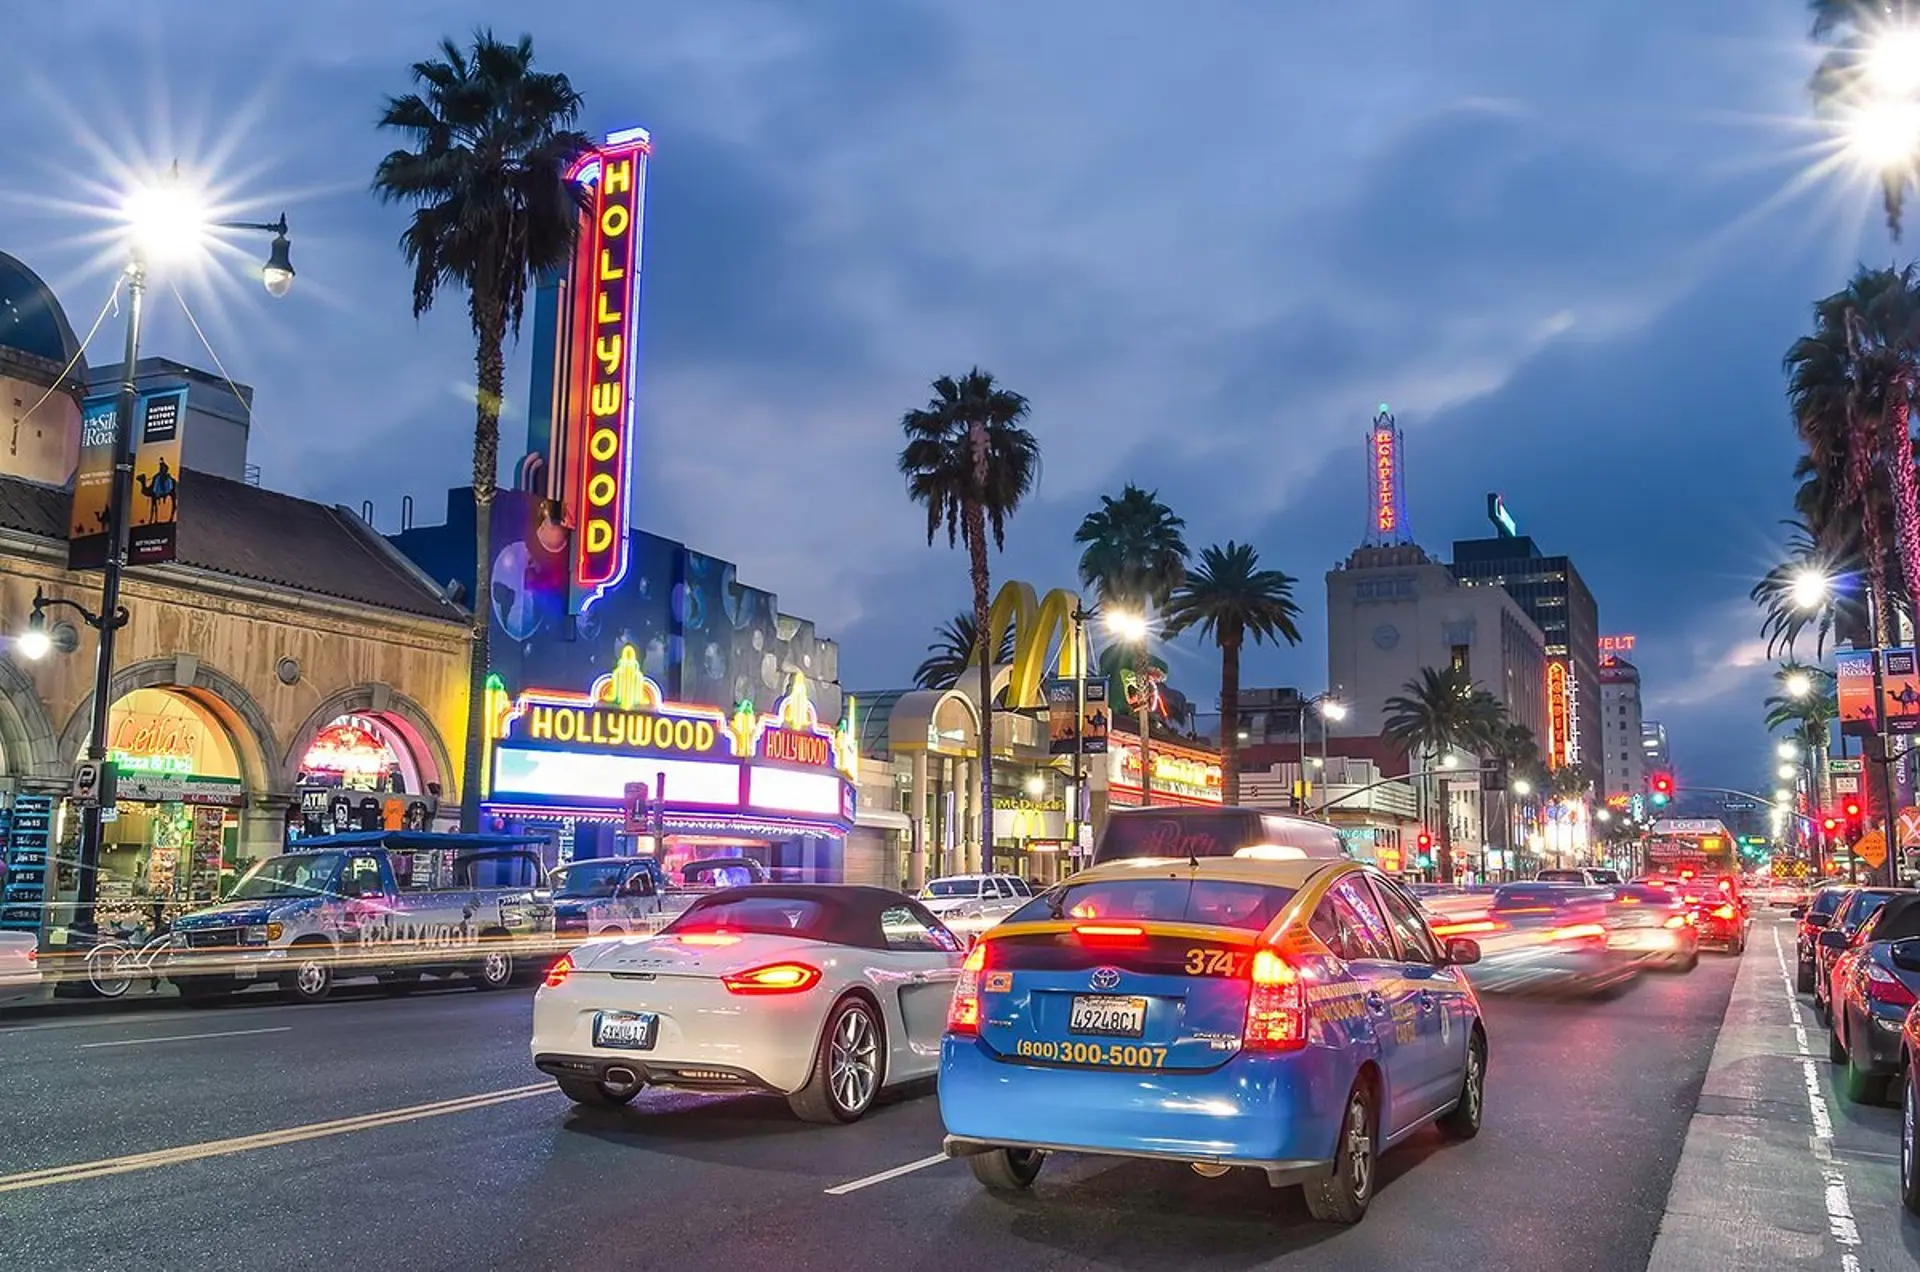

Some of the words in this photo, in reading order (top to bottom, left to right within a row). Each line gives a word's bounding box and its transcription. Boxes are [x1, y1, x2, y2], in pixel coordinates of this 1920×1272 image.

[586, 160, 630, 554] HOLLYWOOD
[532, 706, 714, 752] HOLLYWOOD
[766, 729, 828, 766] HOLLYWOOD
[303, 793, 327, 807] ATM
[1670, 820, 1706, 830] Local
[1074, 1010, 1136, 1031] 49248C1
